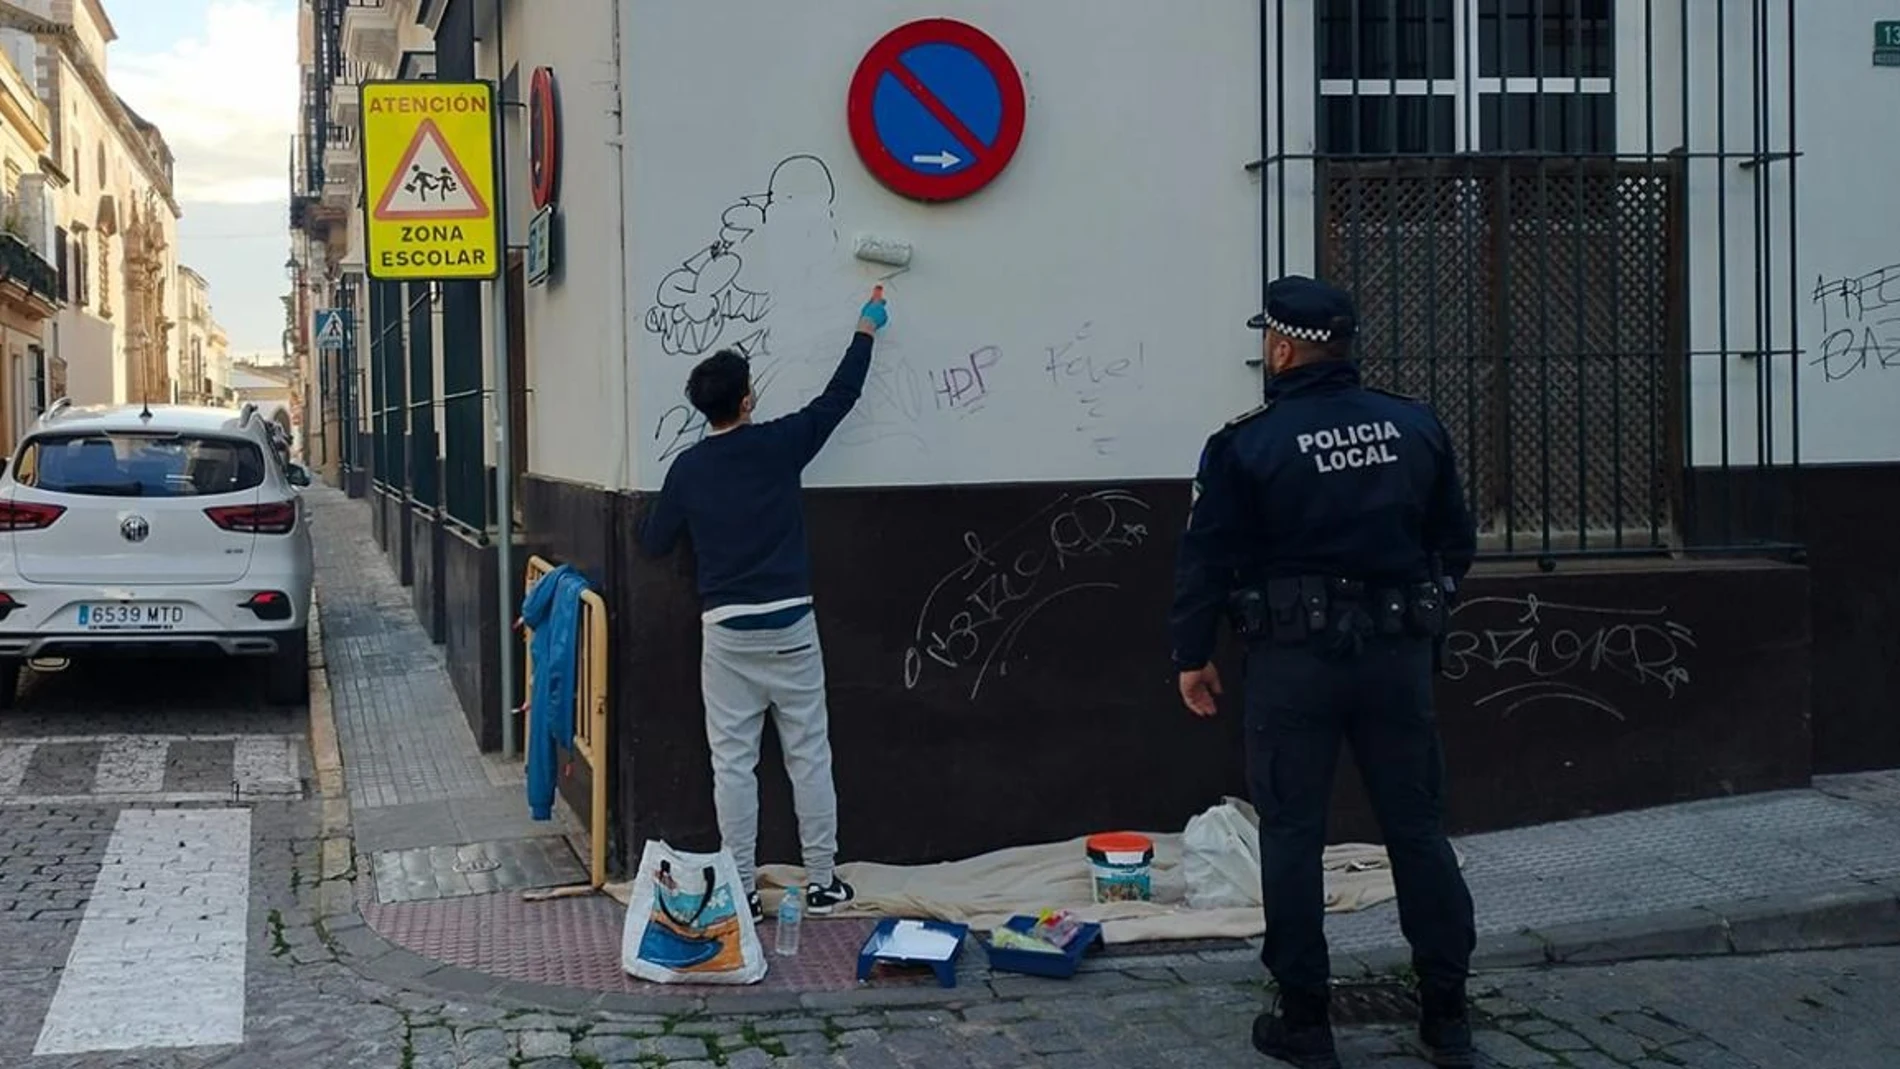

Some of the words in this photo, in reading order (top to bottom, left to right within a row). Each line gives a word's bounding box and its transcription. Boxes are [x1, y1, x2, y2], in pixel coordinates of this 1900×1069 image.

[369, 93, 487, 113] ATENCIÓN
[401, 225, 464, 242] ZONA
[381, 249, 486, 267] ESCOLAR
[1297, 420, 1401, 453] POLICIA
[1315, 444, 1398, 473] LOCAL
[92, 606, 141, 623] 6539
[147, 606, 183, 622] MTD
